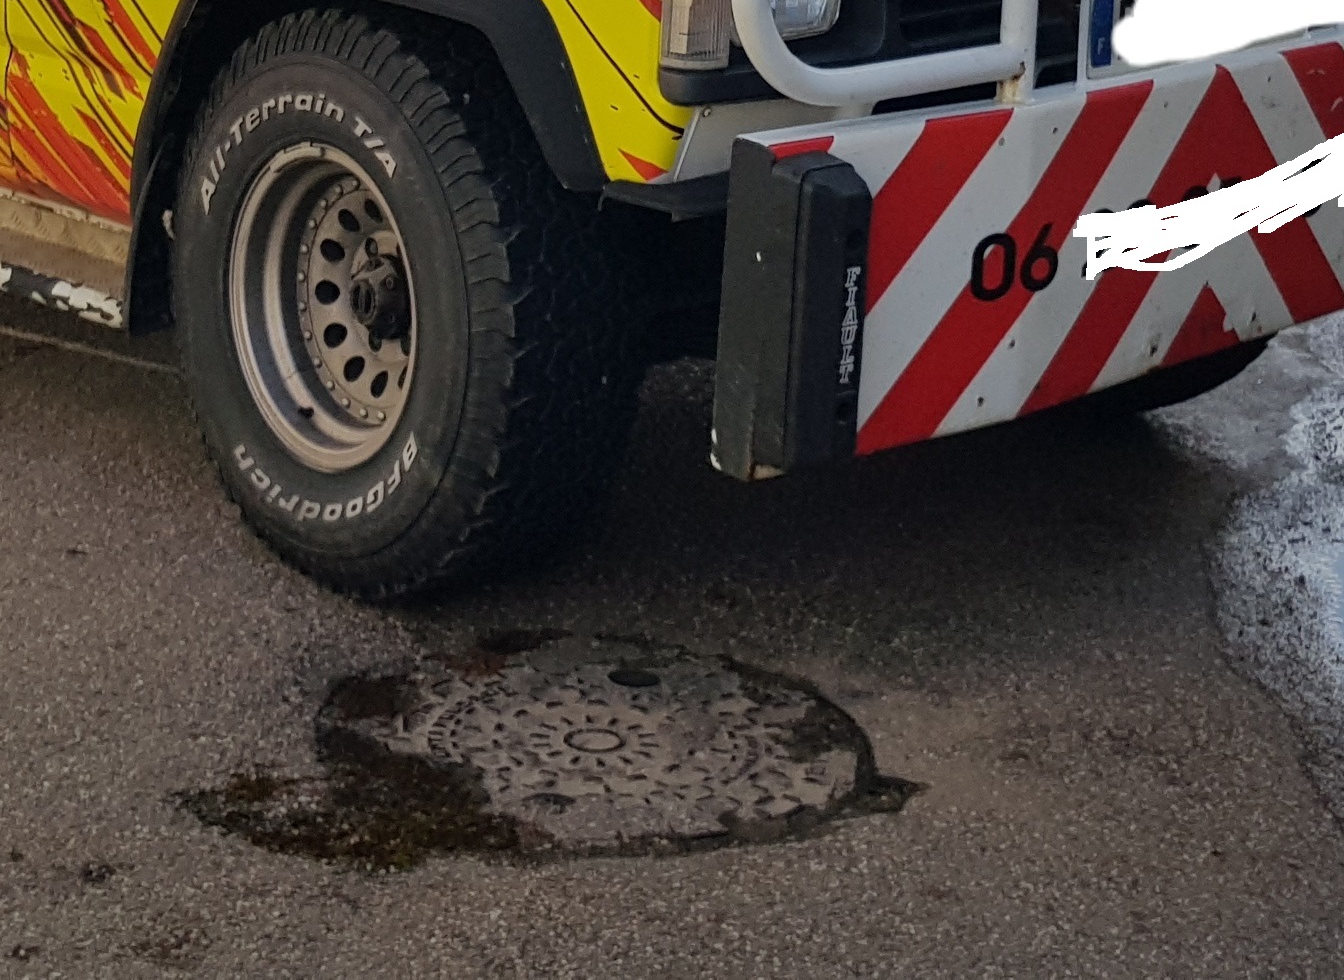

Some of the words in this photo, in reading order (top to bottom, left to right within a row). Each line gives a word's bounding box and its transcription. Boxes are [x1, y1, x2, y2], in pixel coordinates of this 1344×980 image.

[201, 93, 345, 215] All-Terrain
[353, 116, 397, 178] T/A
[970, 223, 1058, 302] 06
[234, 431, 418, 521] BFGoodrich
